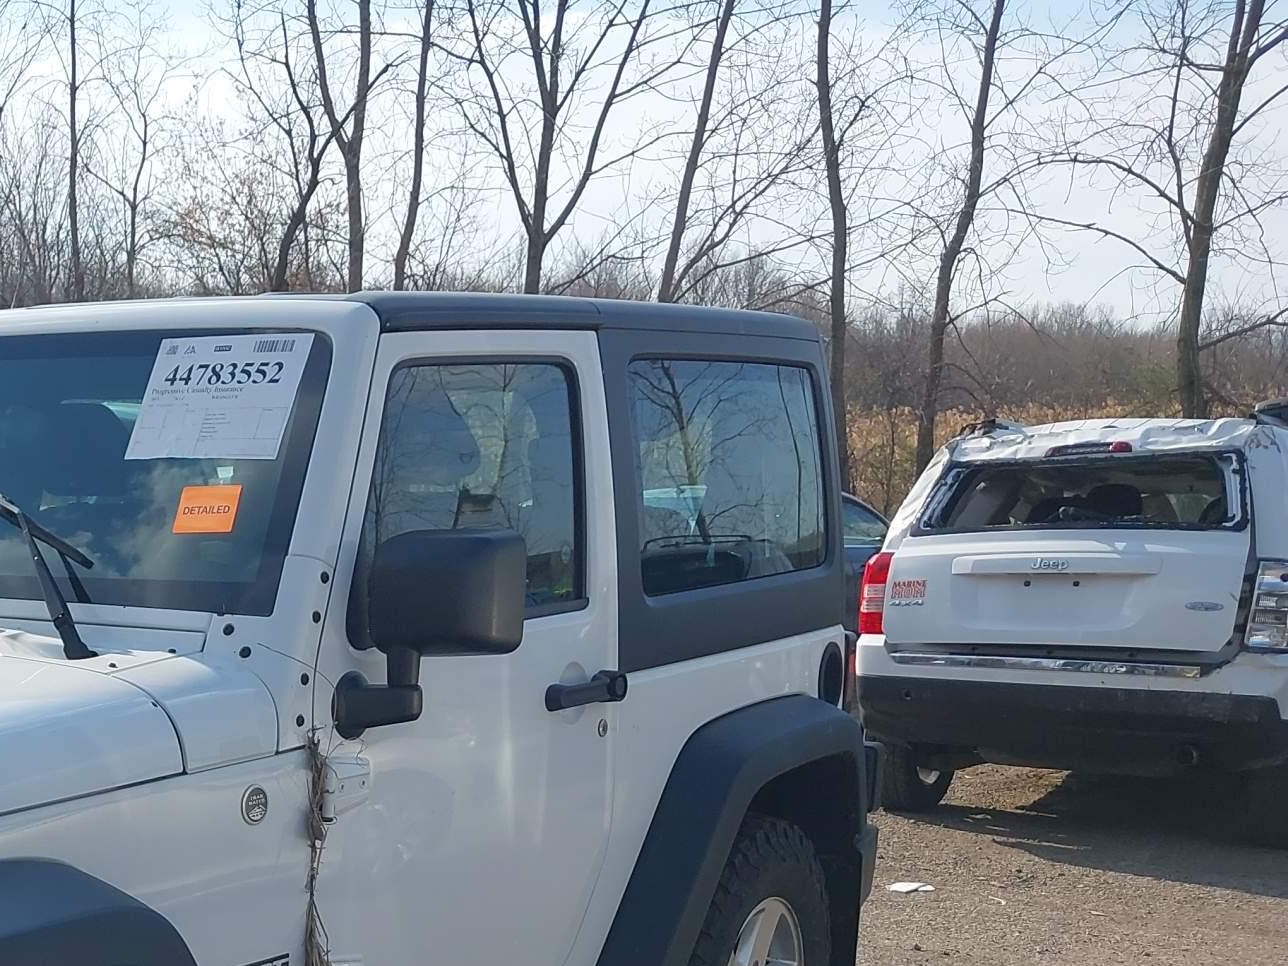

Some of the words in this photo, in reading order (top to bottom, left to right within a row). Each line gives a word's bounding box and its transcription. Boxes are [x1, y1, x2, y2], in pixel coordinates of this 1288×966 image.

[165, 361, 284, 386] 44783552
[214, 385, 245, 393] Insurance
[183, 505, 230, 515] DETAILED
[1031, 557, 1068, 571] Jeep
